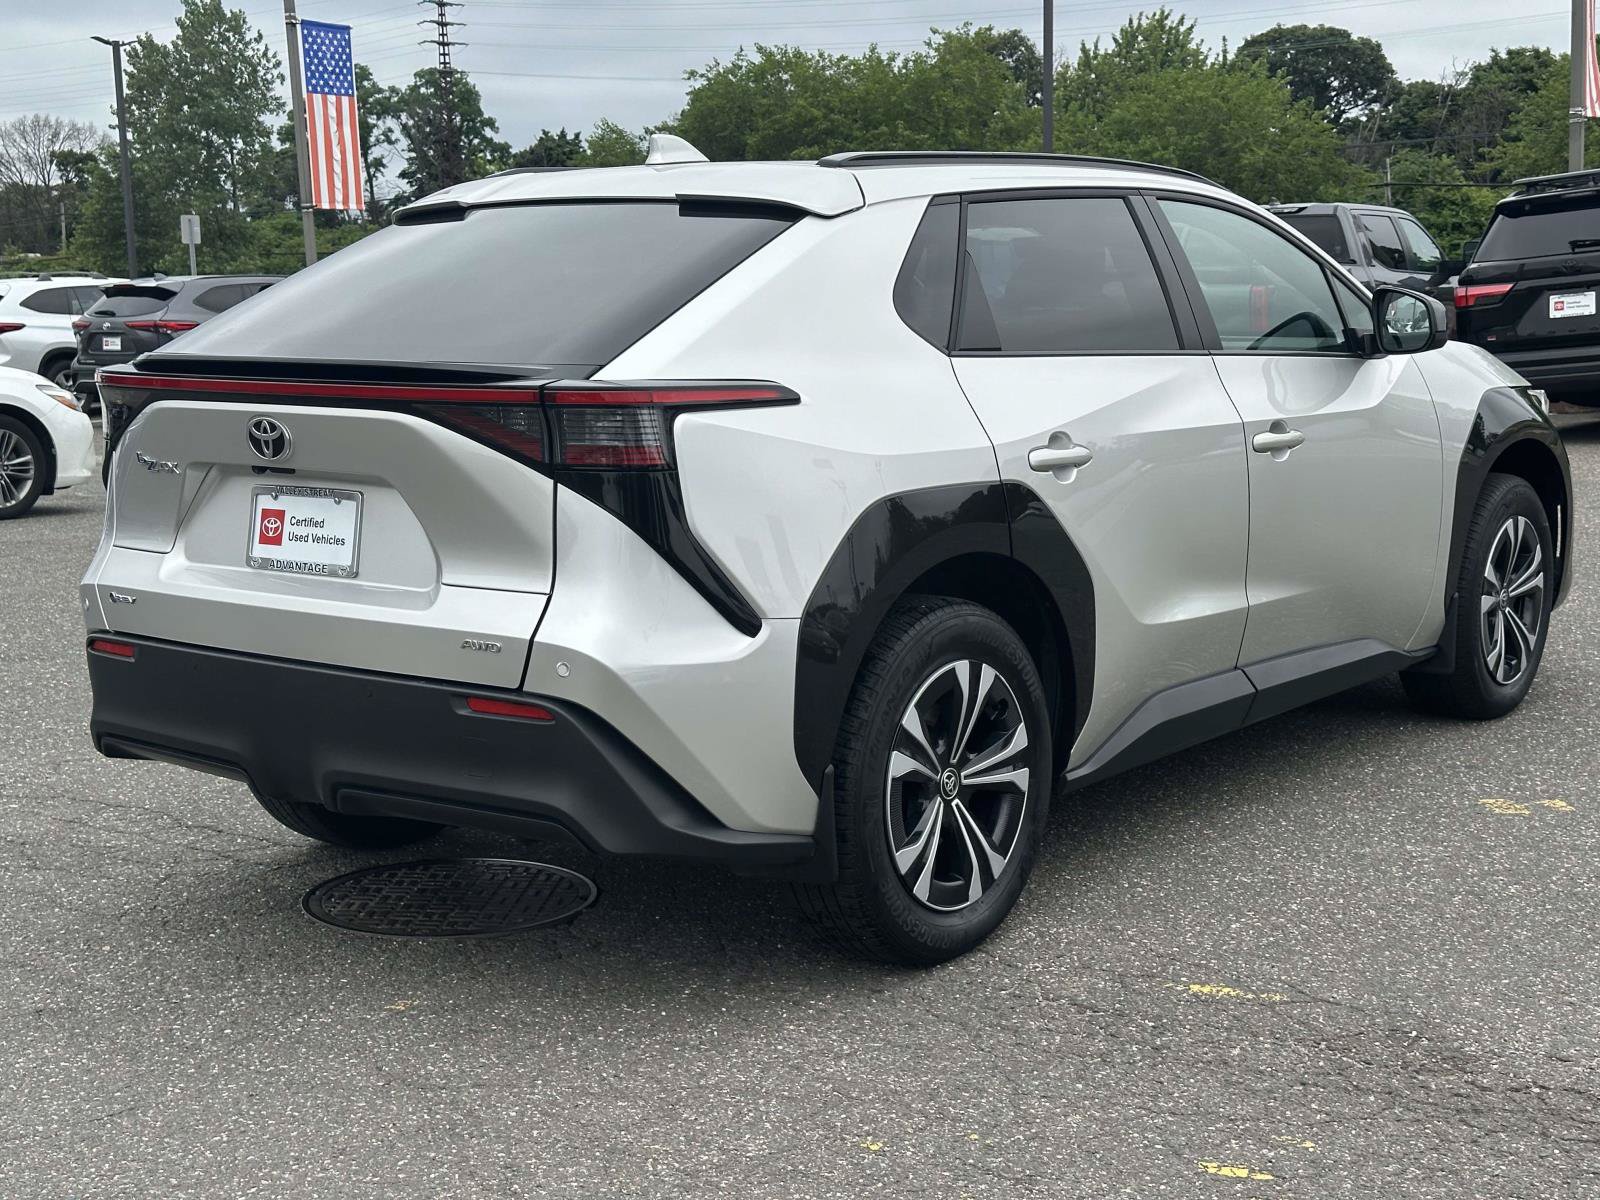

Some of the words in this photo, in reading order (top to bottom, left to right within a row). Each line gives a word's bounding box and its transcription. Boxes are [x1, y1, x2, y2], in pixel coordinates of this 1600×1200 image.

[276, 486, 302, 496] VALLEY
[304, 488, 335, 498] STREAM
[290, 516, 325, 529] Certified
[288, 532, 309, 543] Used
[311, 533, 346, 546] Vehicles
[269, 559, 328, 574] ADVANTAGE
[461, 638, 502, 653] AWD
